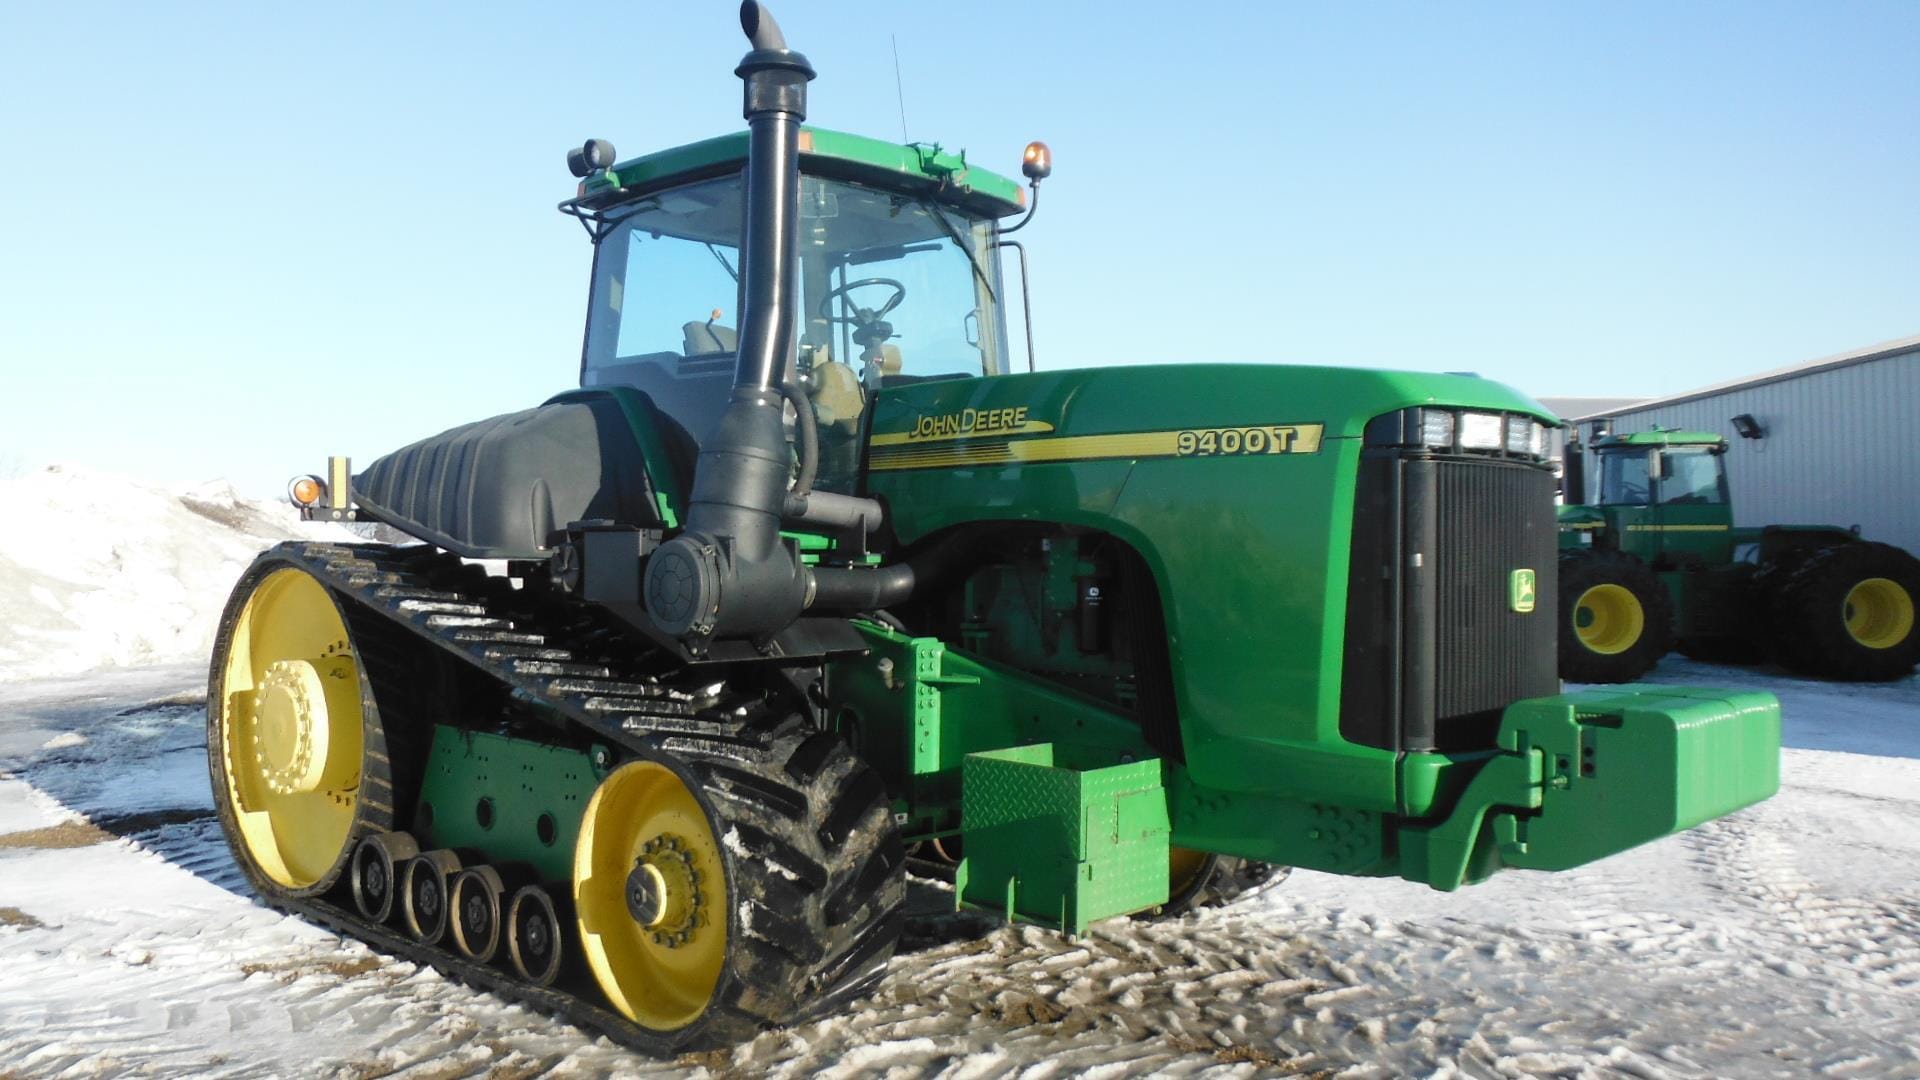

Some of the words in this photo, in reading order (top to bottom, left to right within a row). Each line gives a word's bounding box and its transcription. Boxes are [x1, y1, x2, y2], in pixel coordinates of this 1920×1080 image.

[910, 413, 960, 436] JOHN
[961, 407, 1028, 431] DEERE
[1178, 426, 1295, 455] 9400T
